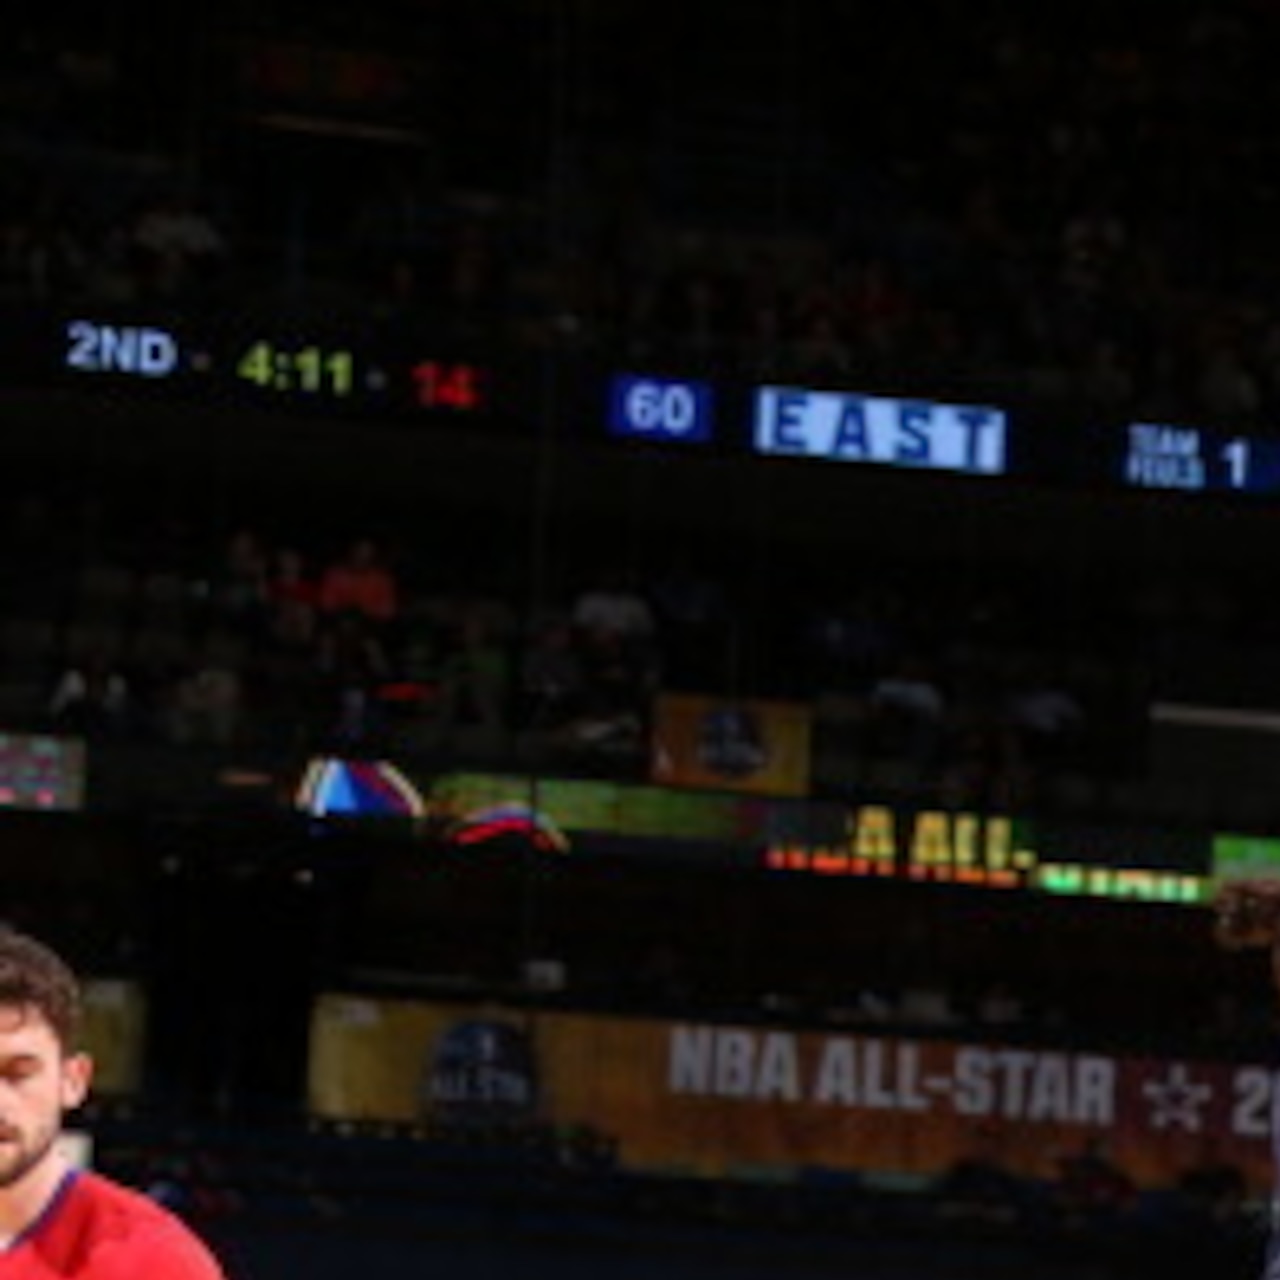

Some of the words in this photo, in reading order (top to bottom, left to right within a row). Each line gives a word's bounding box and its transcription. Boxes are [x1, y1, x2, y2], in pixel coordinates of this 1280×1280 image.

[66, 320, 176, 376] 2ND
[237, 340, 353, 396] 4:11
[412, 361, 483, 409] 14
[627, 383, 695, 433] 60
[776, 392, 992, 469] EAST
[1221, 437, 1251, 490] 1
[670, 1026, 798, 1101] NBA
[817, 1038, 1114, 1122] ALL-STAR
